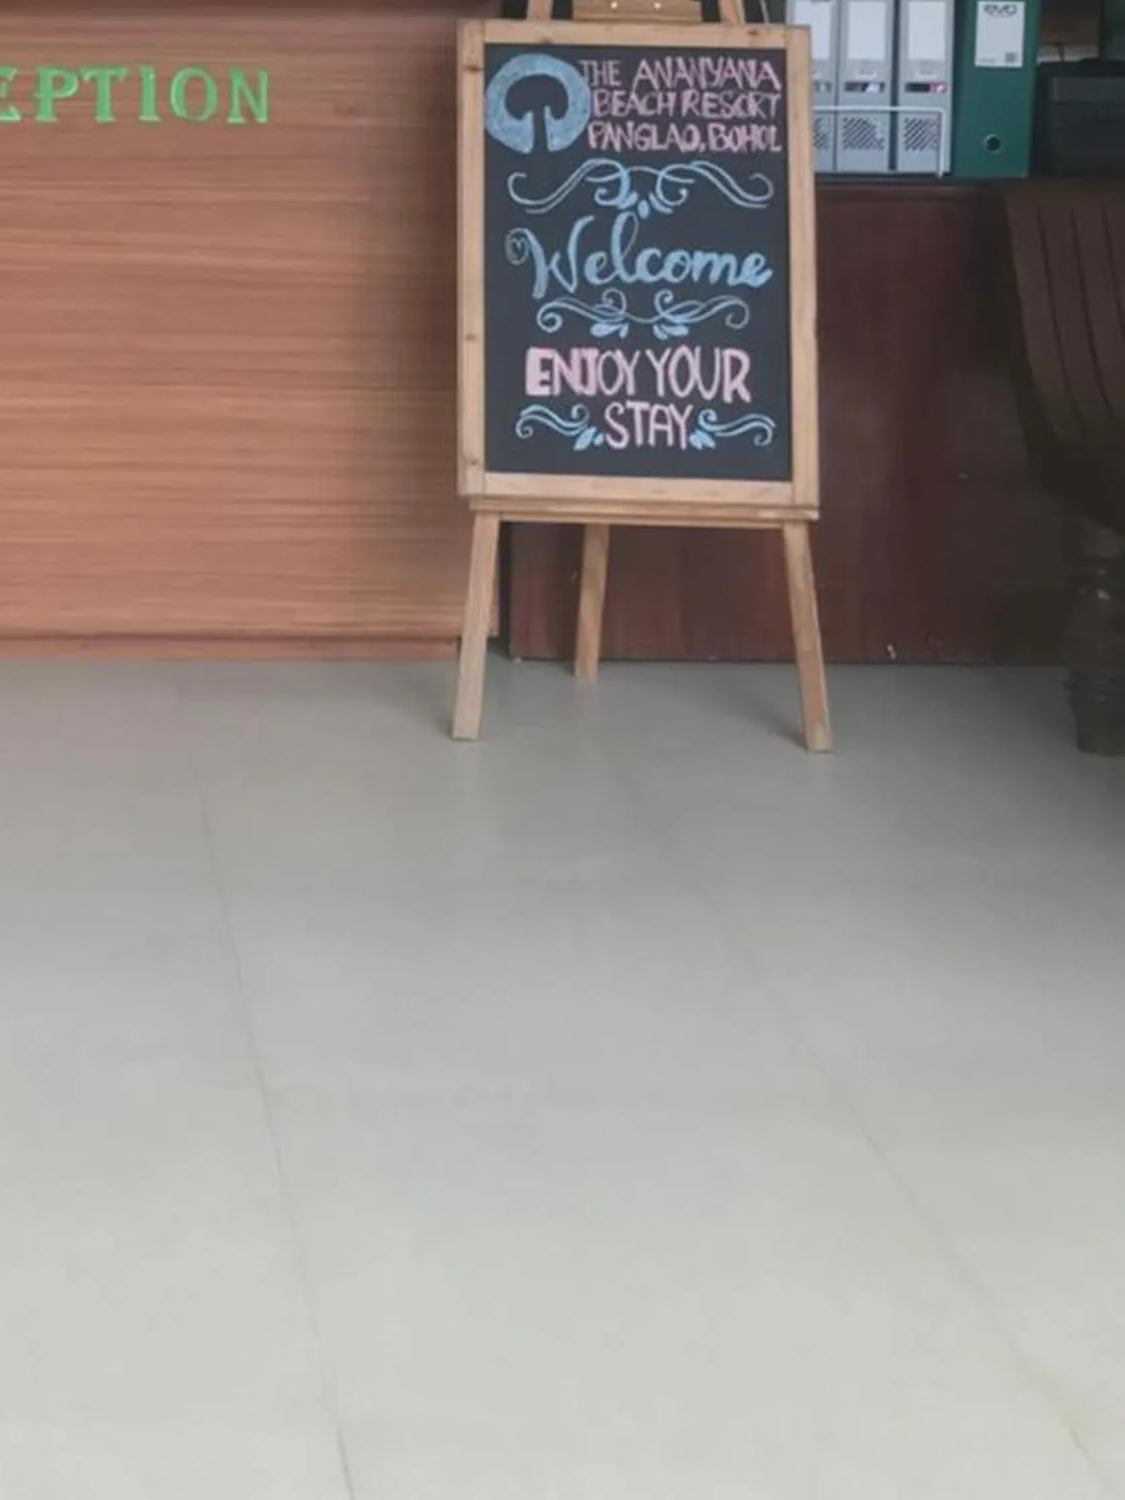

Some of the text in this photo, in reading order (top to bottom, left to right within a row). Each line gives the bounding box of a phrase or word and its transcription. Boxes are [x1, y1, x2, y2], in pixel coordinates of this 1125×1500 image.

[578, 60, 622, 87] THE
[593, 88, 781, 120] BEACH RESORT
[707, 122, 782, 152] BOHOL
[506, 209, 773, 299] Welcome
[525, 344, 752, 403] ENJOY YOUR
[604, 401, 695, 450] STAY
